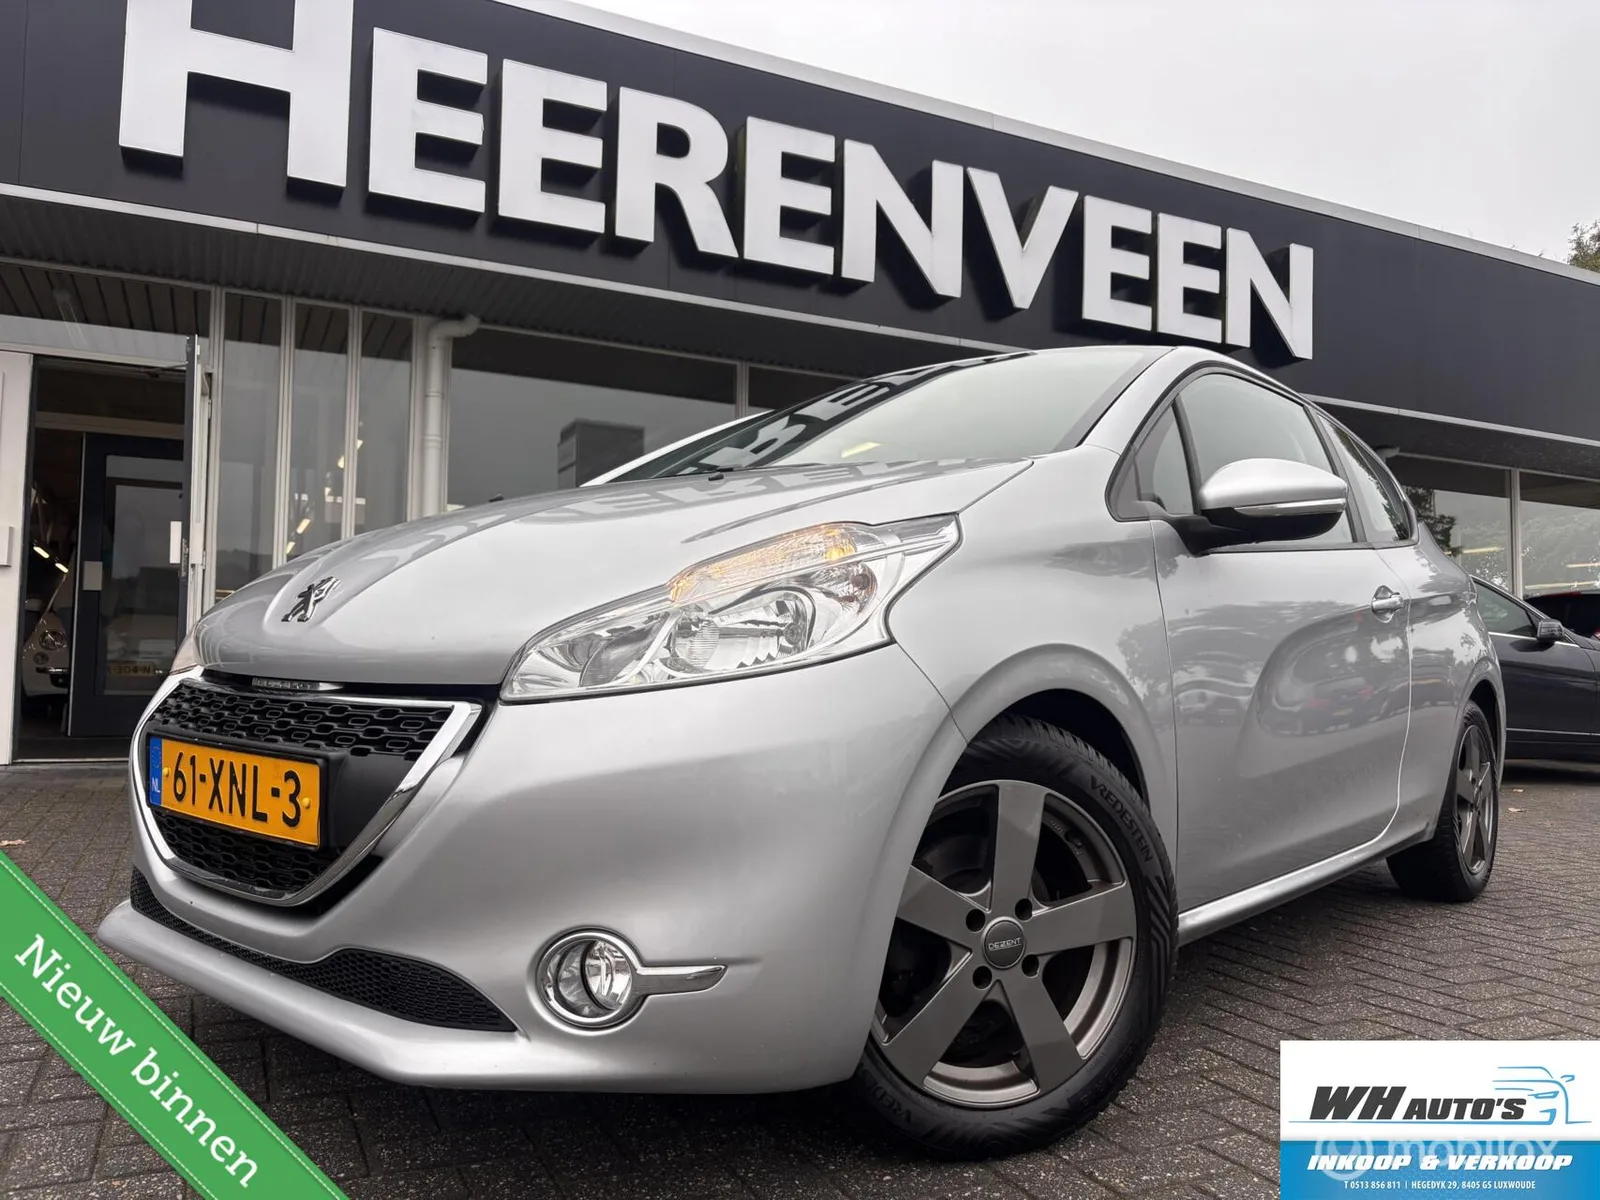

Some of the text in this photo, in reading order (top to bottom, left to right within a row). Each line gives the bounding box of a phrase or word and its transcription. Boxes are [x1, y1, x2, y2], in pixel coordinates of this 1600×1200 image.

[119, 0, 1314, 361] HEERENVEEN
[151, 778, 161, 793] NL
[173, 752, 302, 828] 61-XNL-3
[1090, 775, 1154, 862] VREDESTEIN
